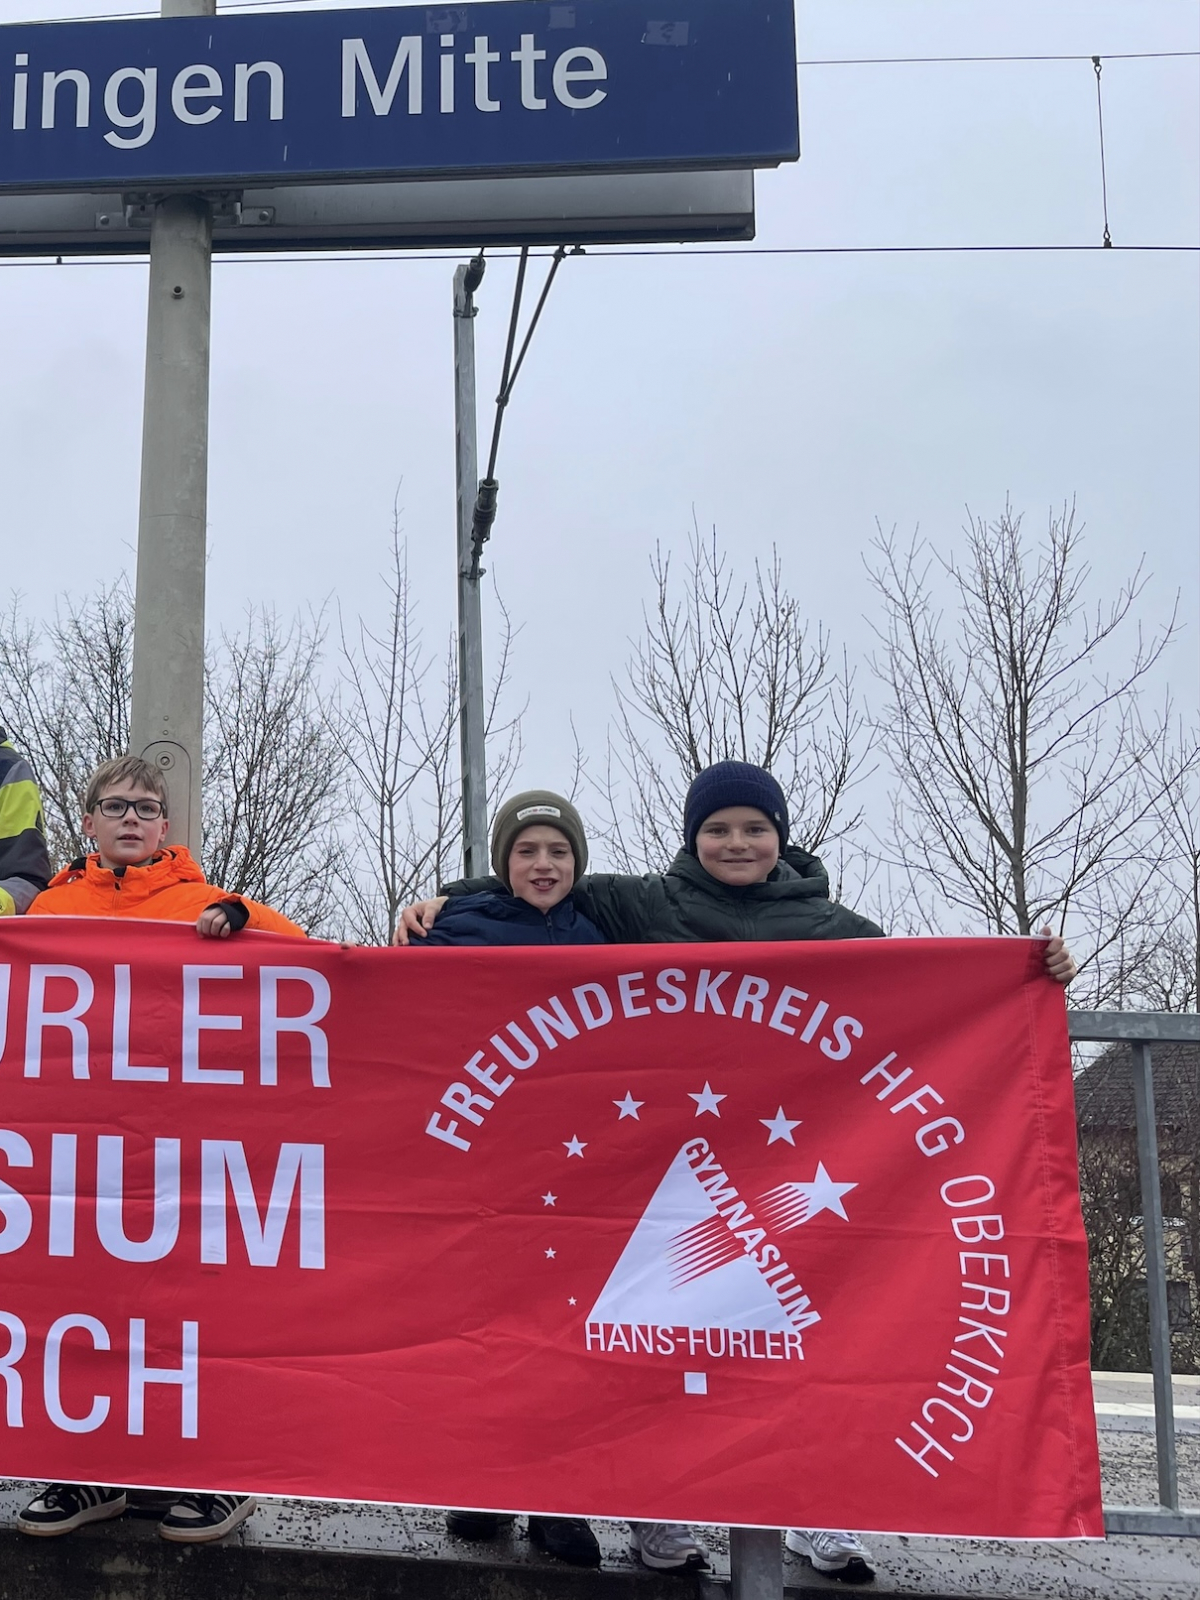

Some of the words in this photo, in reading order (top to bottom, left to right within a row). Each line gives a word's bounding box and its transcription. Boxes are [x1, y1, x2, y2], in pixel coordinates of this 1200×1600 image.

[340, 33, 608, 117] Mitte
[424, 967, 865, 1153] FREUNDESKREIS
[859, 1051, 966, 1158] HFG
[681, 1136, 822, 1329] GYMNASIUM
[584, 1320, 805, 1361] HANS-FURLER
[894, 1174, 1012, 1479] OBERKIRCH
